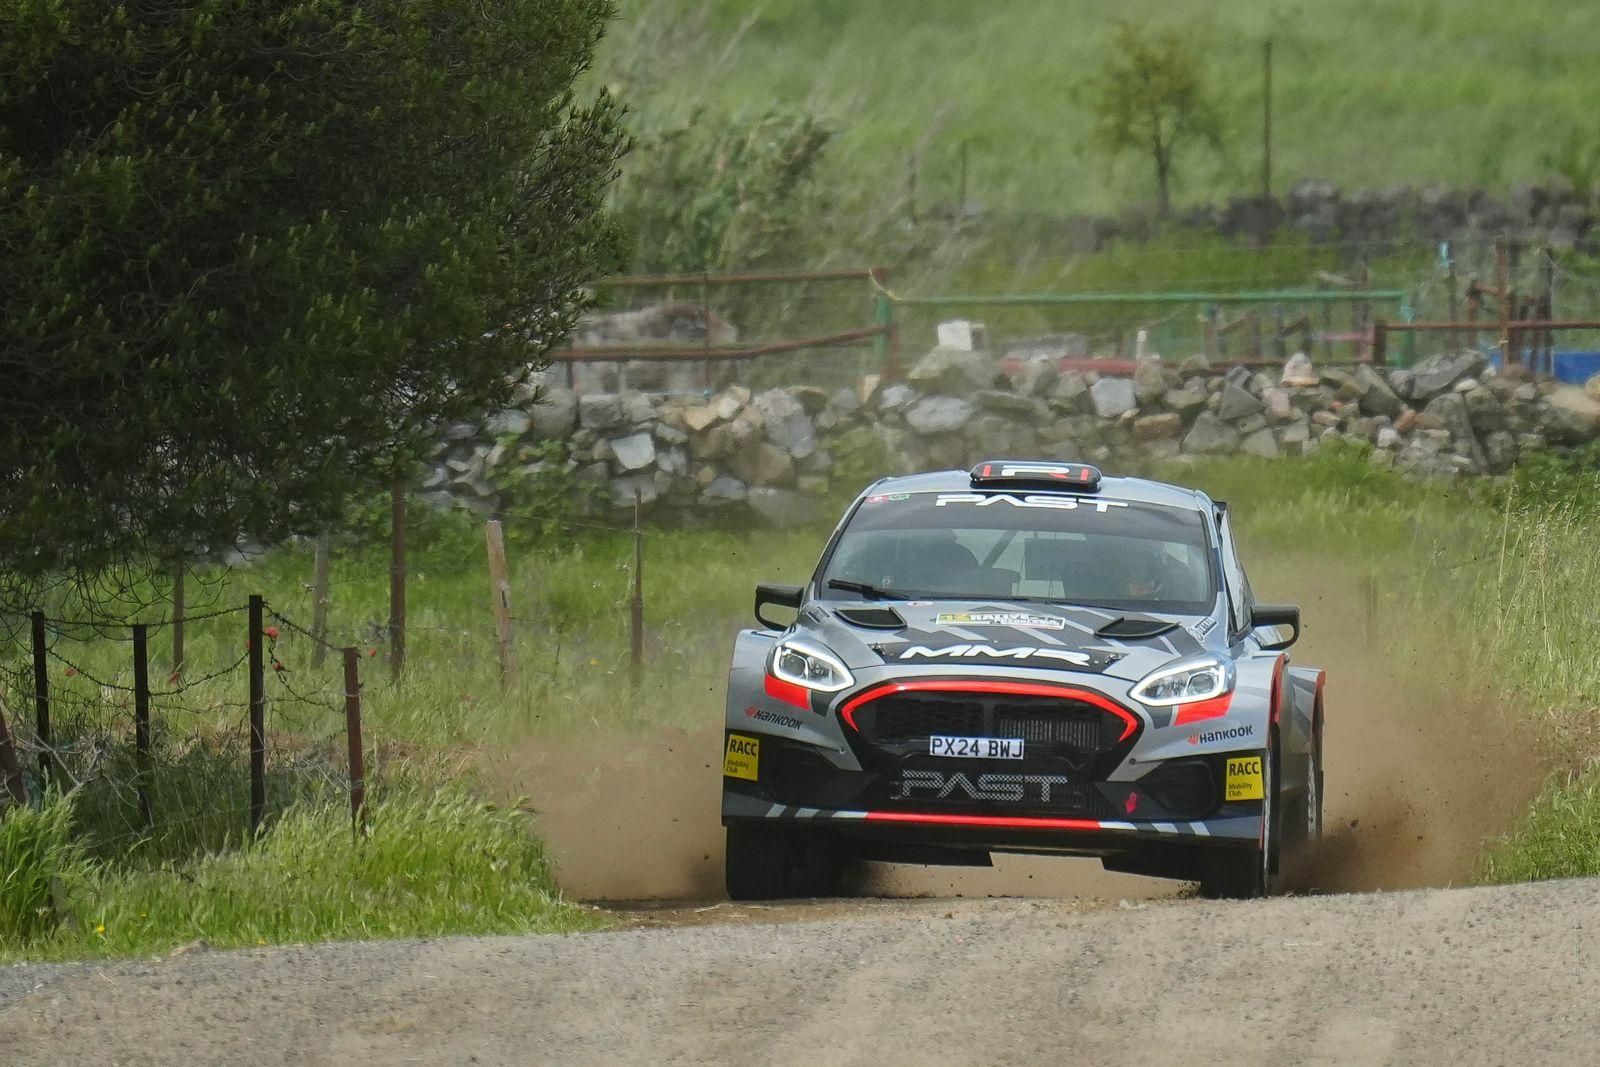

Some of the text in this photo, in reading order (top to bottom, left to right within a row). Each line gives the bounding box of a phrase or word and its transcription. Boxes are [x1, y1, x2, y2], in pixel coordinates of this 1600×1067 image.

[935, 493, 1129, 513] PAST
[899, 644, 1091, 667] MMR
[729, 738, 758, 757] RACC
[931, 737, 1024, 759] PX24 BWJ
[1228, 761, 1260, 777] RACC
[902, 769, 1069, 802] PAST
[1228, 783, 1253, 792] Mobility
